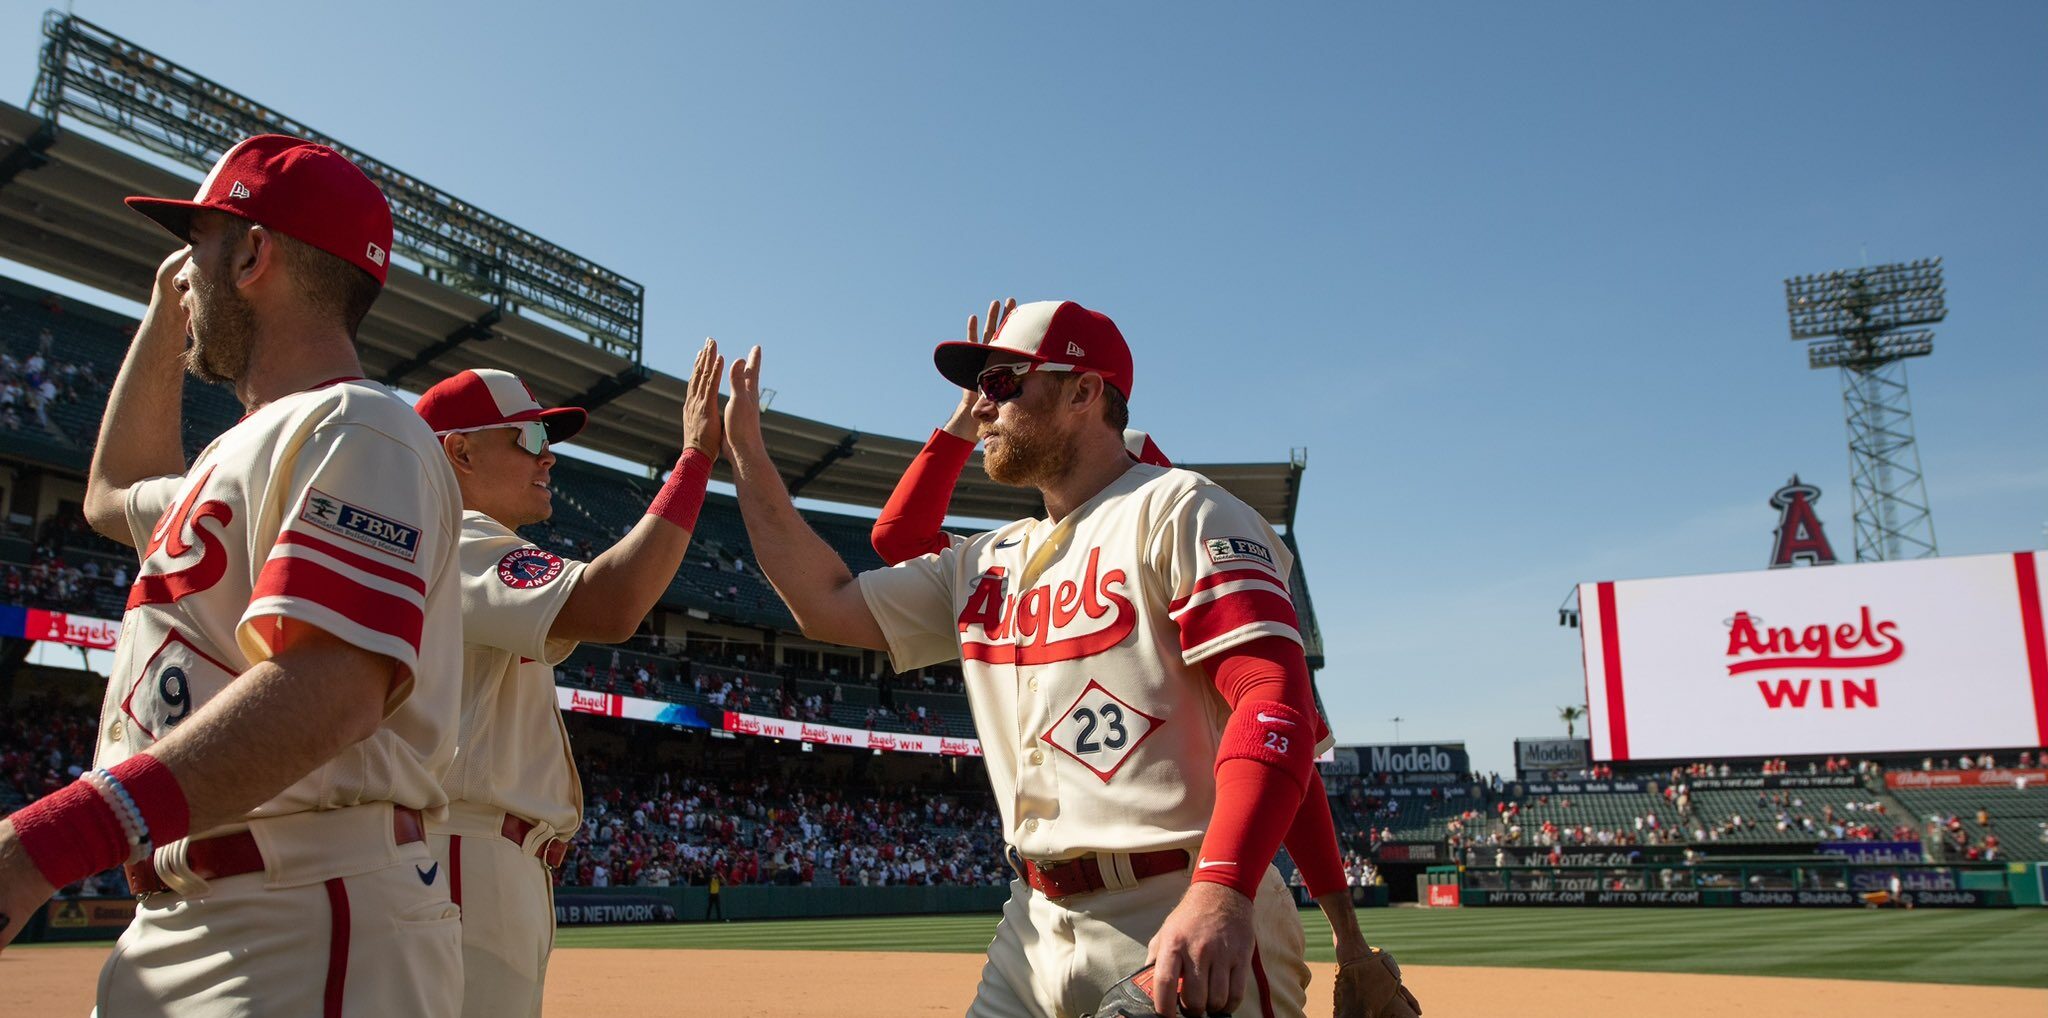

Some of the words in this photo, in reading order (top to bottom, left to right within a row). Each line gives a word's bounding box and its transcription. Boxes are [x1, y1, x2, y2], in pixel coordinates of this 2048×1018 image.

[344, 529, 377, 548] Building
[346, 510, 411, 546] FBM
[502, 550, 553, 569] ANGELES
[1235, 540, 1270, 560] FBM
[525, 561, 560, 588] ANGELS
[958, 546, 1137, 666] Angels
[1724, 606, 1906, 677] Angels
[159, 666, 191, 726] 9
[1757, 678, 1879, 710] WIN
[763, 725, 785, 736] WIN
[801, 722, 829, 743] Angels
[832, 733, 853, 743] WIN
[868, 731, 897, 751] Angels
[900, 741, 923, 750] WIN
[940, 737, 970, 756] Angels
[1073, 703, 1129, 755] 23
[1264, 731, 1289, 753] 23
[1371, 746, 1451, 772] Modelo
[1528, 744, 1577, 762] Modelo
[584, 904, 654, 922] NETWORK
